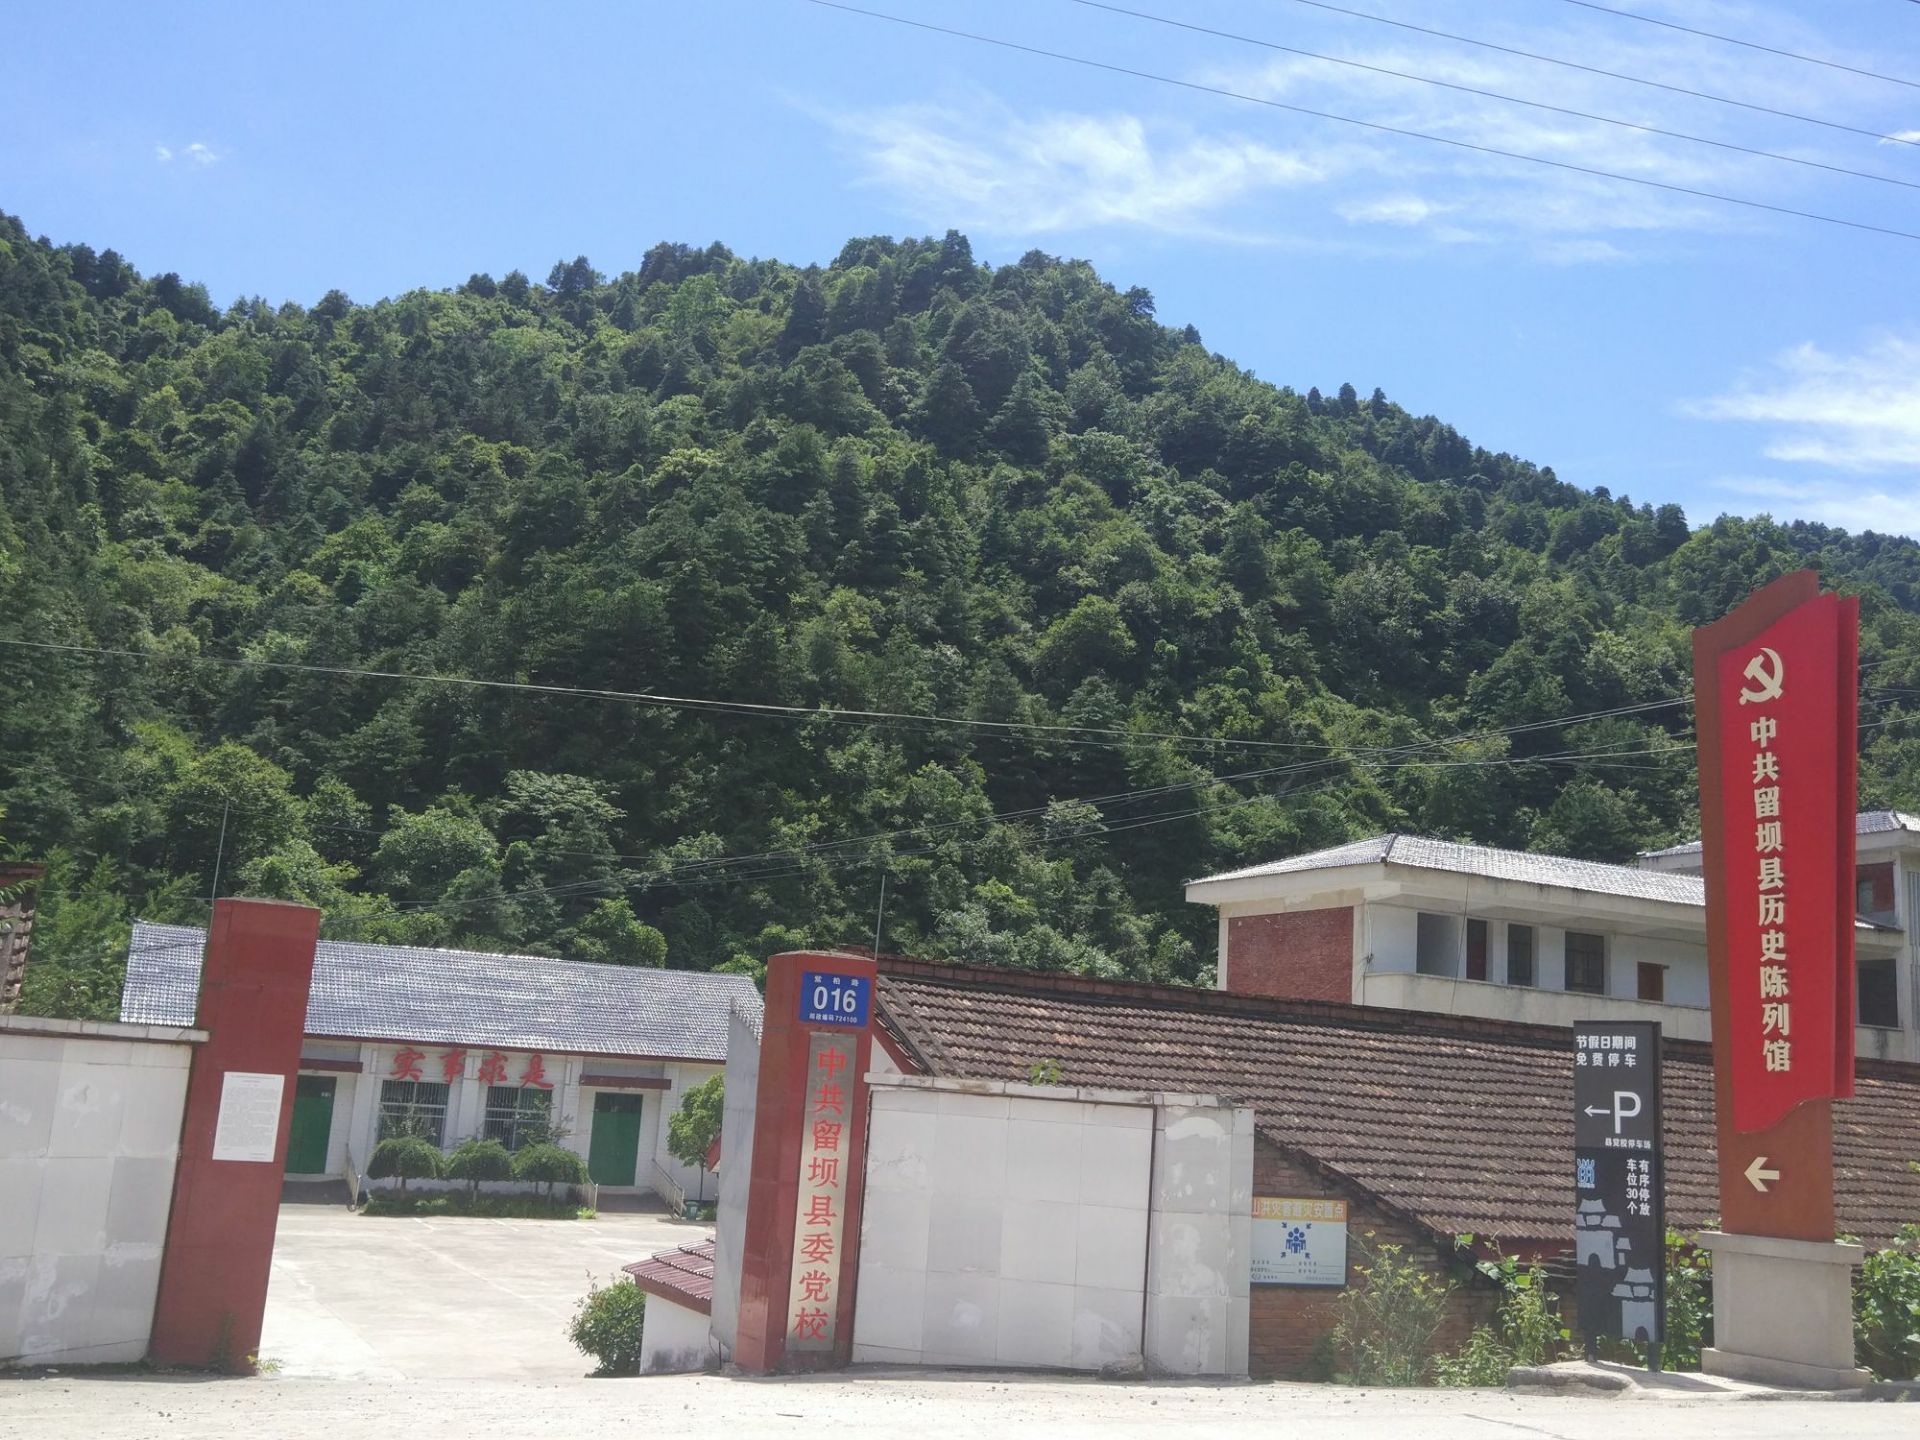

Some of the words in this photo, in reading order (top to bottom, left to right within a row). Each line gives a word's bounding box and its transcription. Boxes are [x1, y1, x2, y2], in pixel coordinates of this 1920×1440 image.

[1748, 715, 1793, 1074] 中共留坝县历史陈列馆
[813, 986, 857, 1013] 016
[1576, 1035, 1637, 1050] 节假日期间
[1576, 1052, 1637, 1067] 免费停车
[390, 1047, 554, 1088] 实事求是
[1614, 1091, 1642, 1134] P
[792, 1047, 847, 1341] 中共留坝县委党校
[1626, 1158, 1639, 1215] 车位30个
[1638, 1159, 1651, 1216] 有序停放
